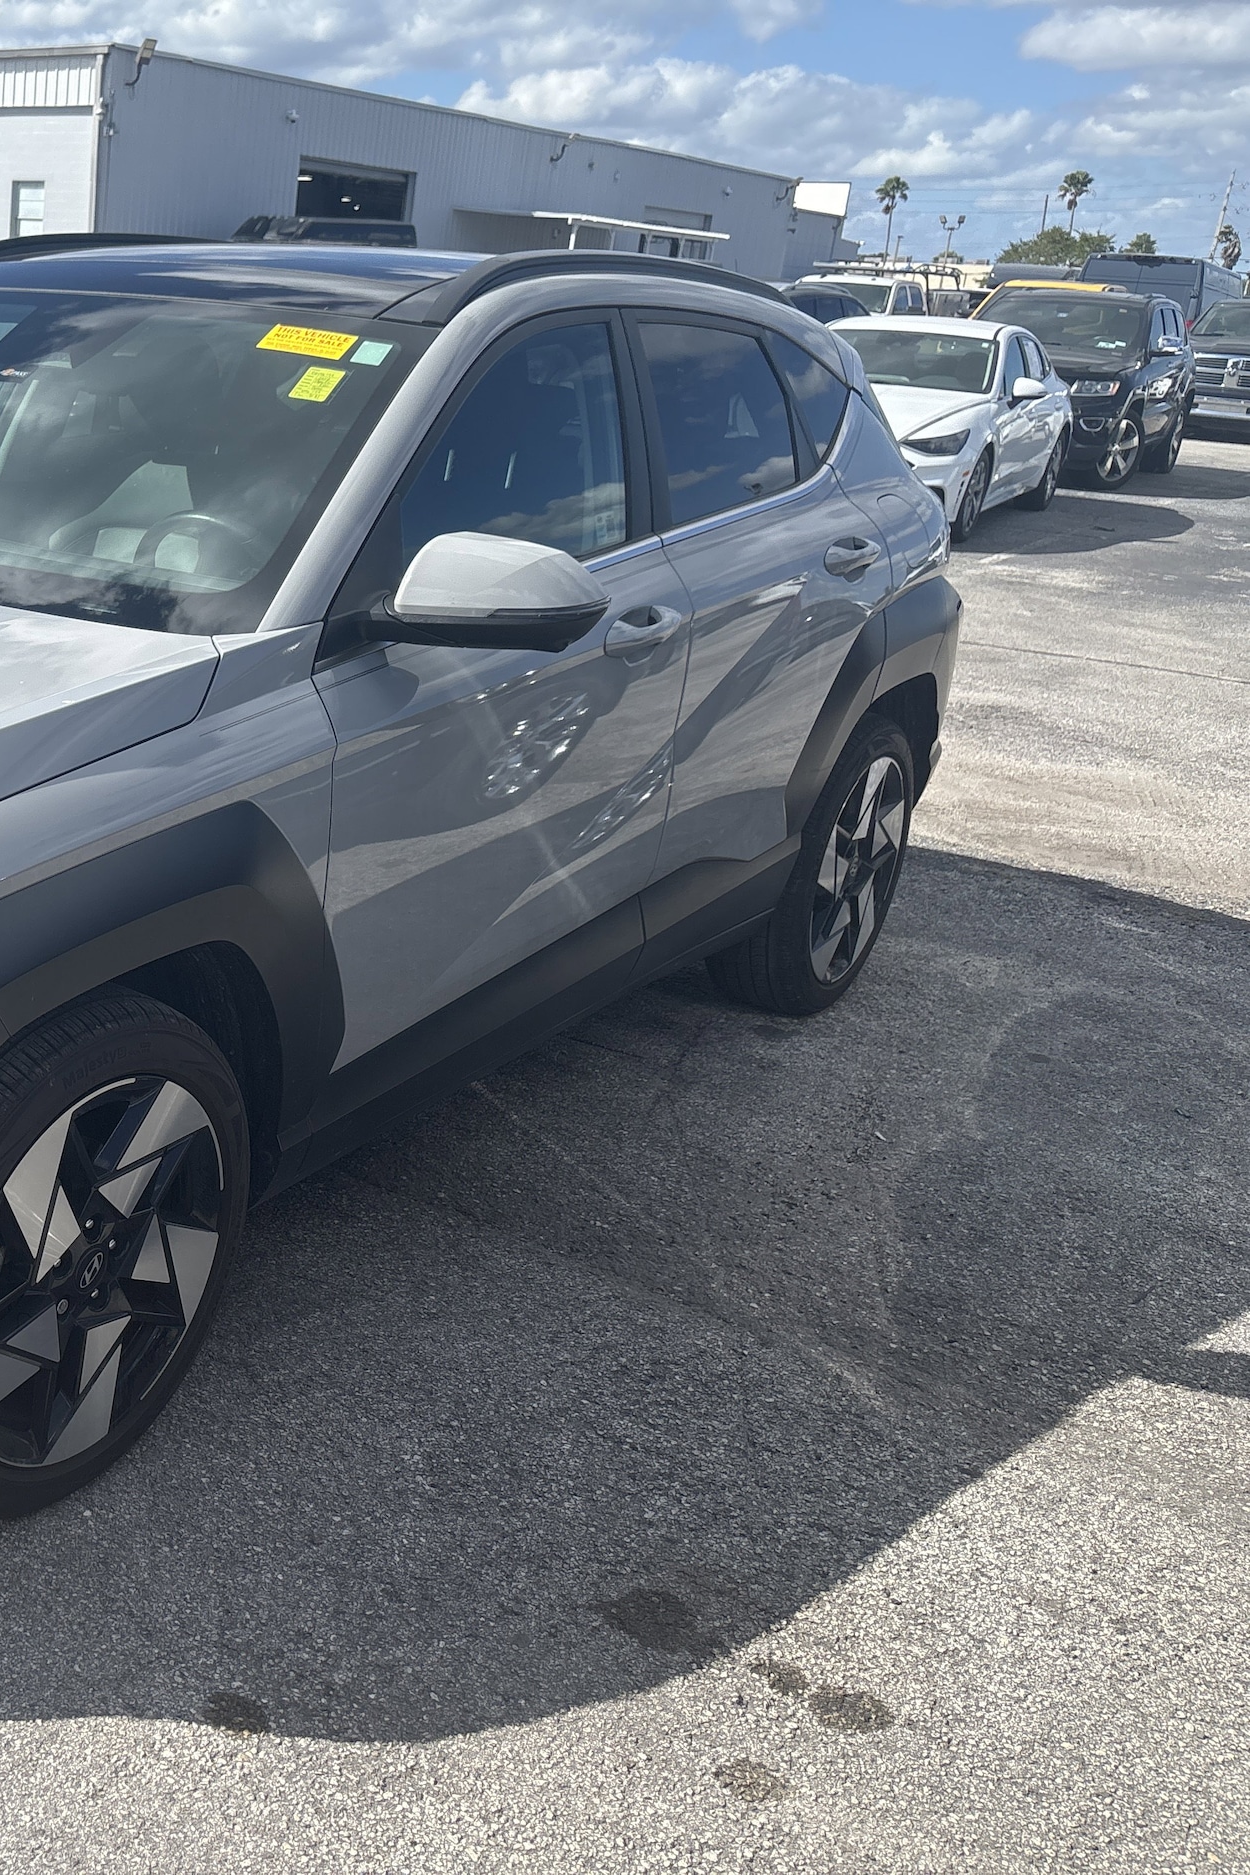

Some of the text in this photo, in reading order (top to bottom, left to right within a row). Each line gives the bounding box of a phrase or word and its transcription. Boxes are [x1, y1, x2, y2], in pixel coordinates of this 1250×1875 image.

[277, 327, 352, 343] THIS VEHICLE
[318, 339, 345, 347] SALE
